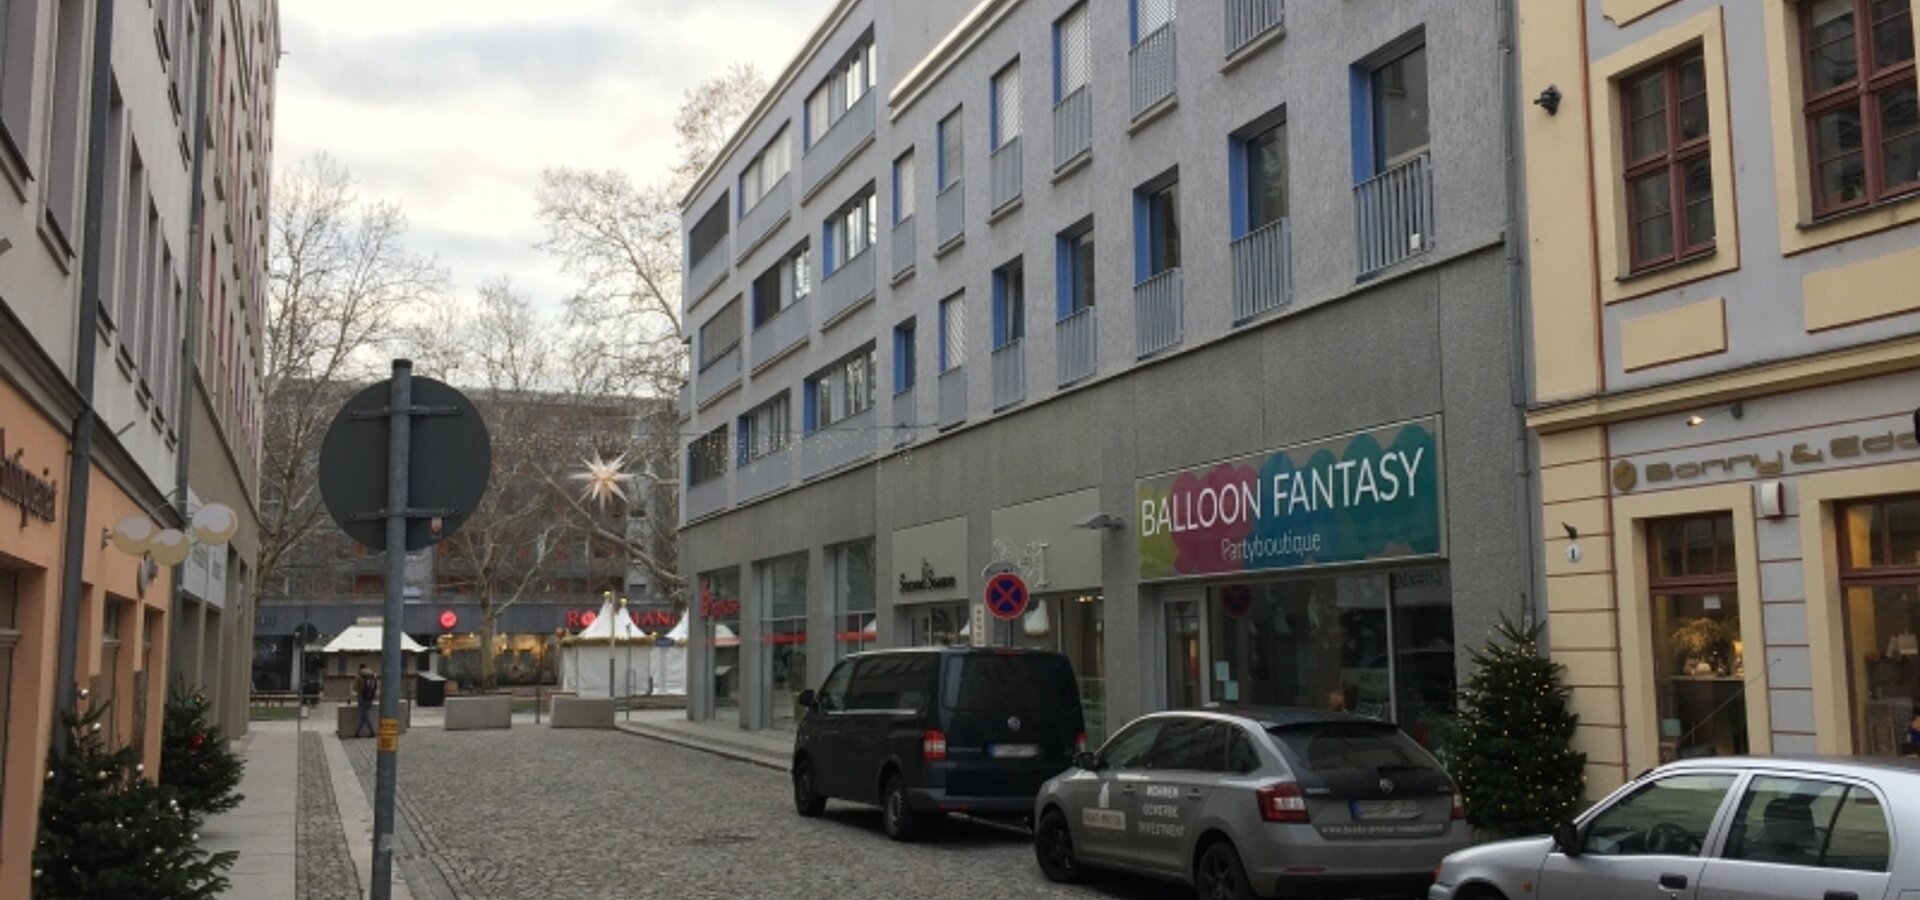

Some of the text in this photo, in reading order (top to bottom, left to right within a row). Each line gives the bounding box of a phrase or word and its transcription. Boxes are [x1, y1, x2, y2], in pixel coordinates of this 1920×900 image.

[1791, 442, 1823, 465] &
[1141, 446, 1425, 537] BALLOON FANTASY
[1221, 532, 1322, 563] Partyboutique
